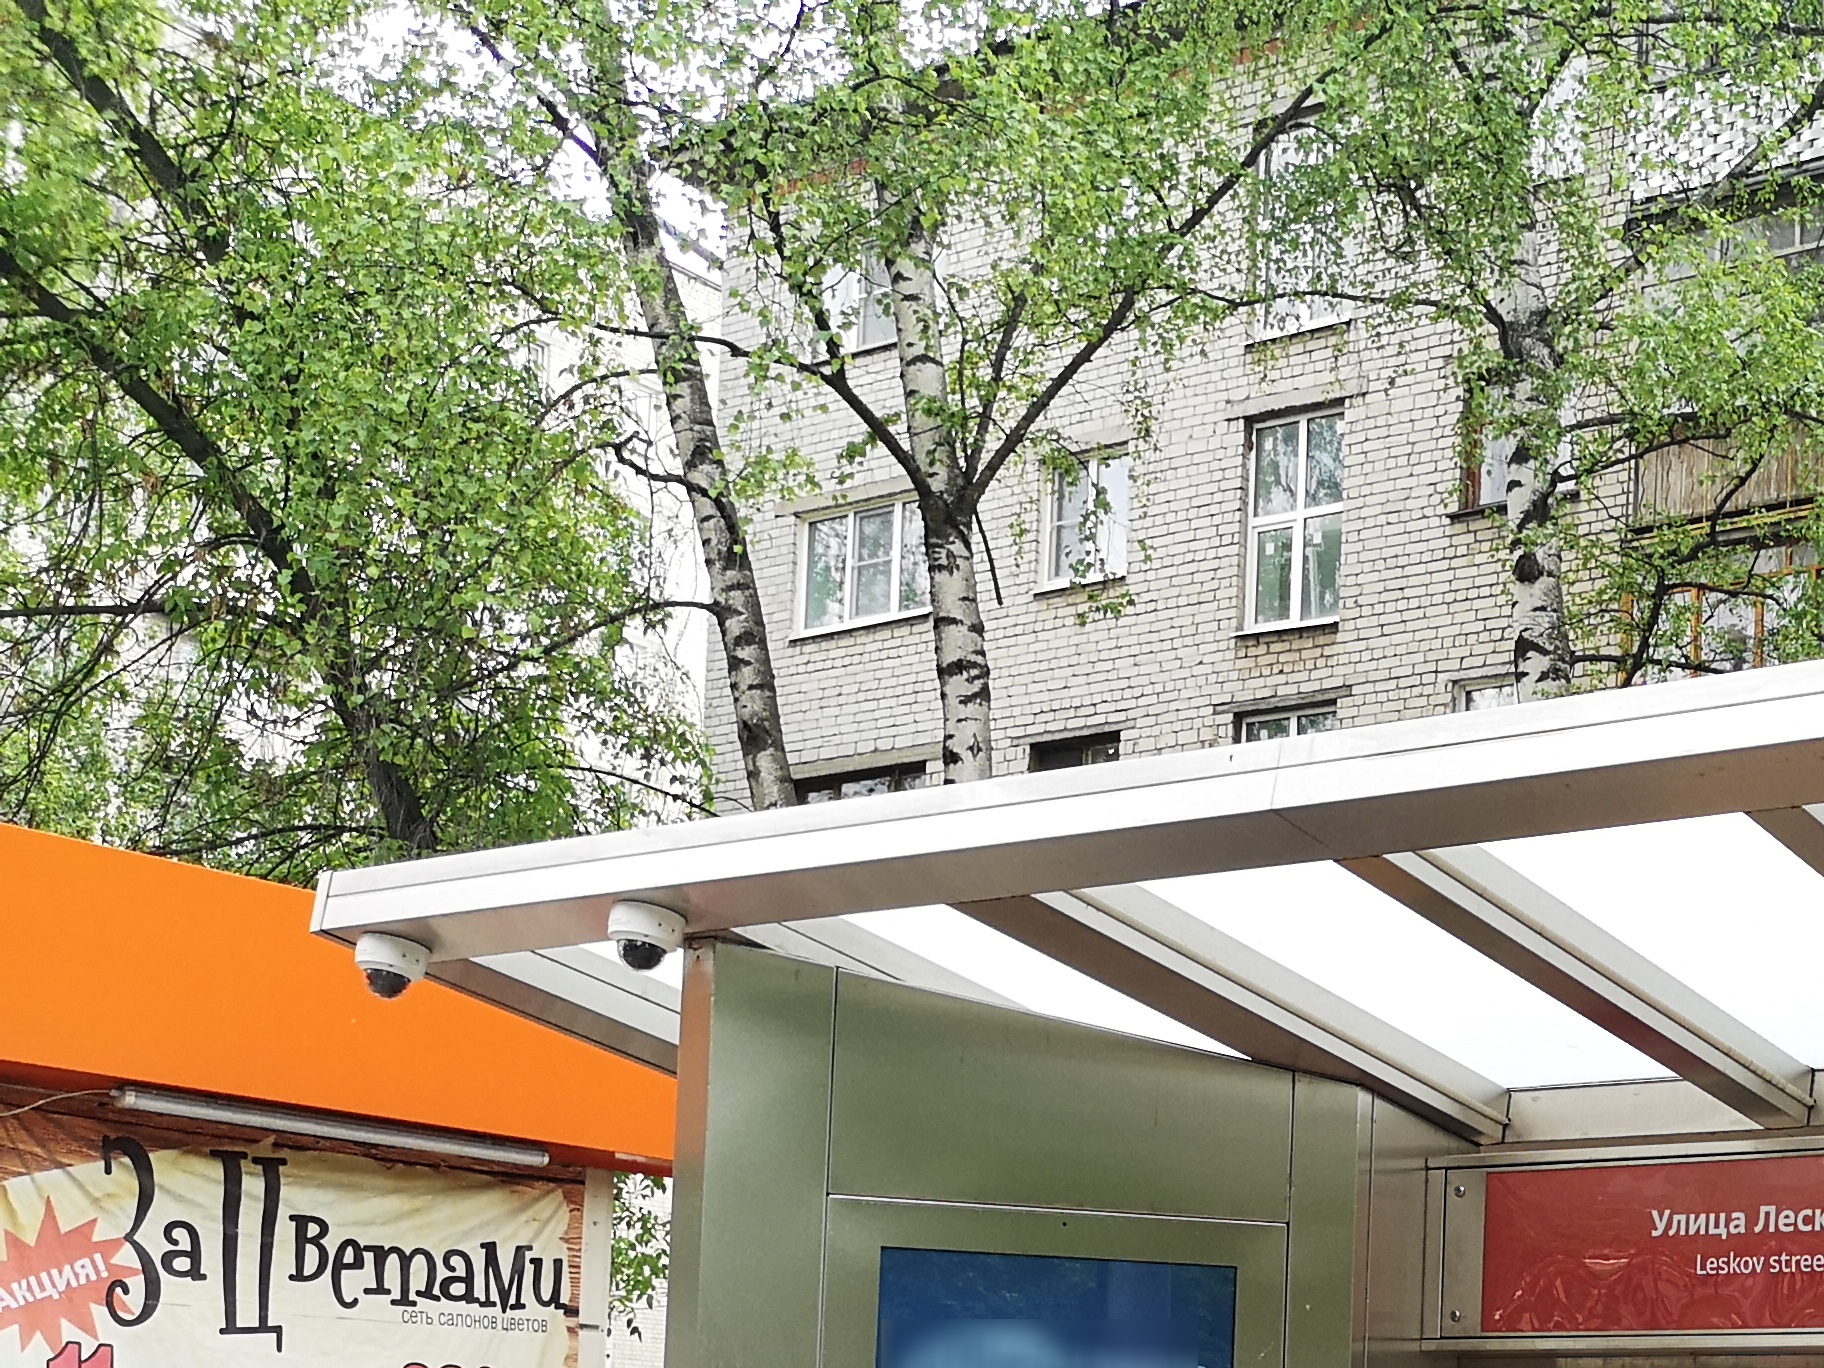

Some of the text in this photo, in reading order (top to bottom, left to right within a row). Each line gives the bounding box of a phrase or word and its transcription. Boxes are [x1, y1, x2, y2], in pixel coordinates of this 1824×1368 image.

[1650, 1209, 1746, 1240] Улица
[1696, 1251, 1765, 1275] Leskov
[0, 1252, 109, 1314] АКЦИЯ!
[401, 1309, 549, 1333] сеть салонов цветов
